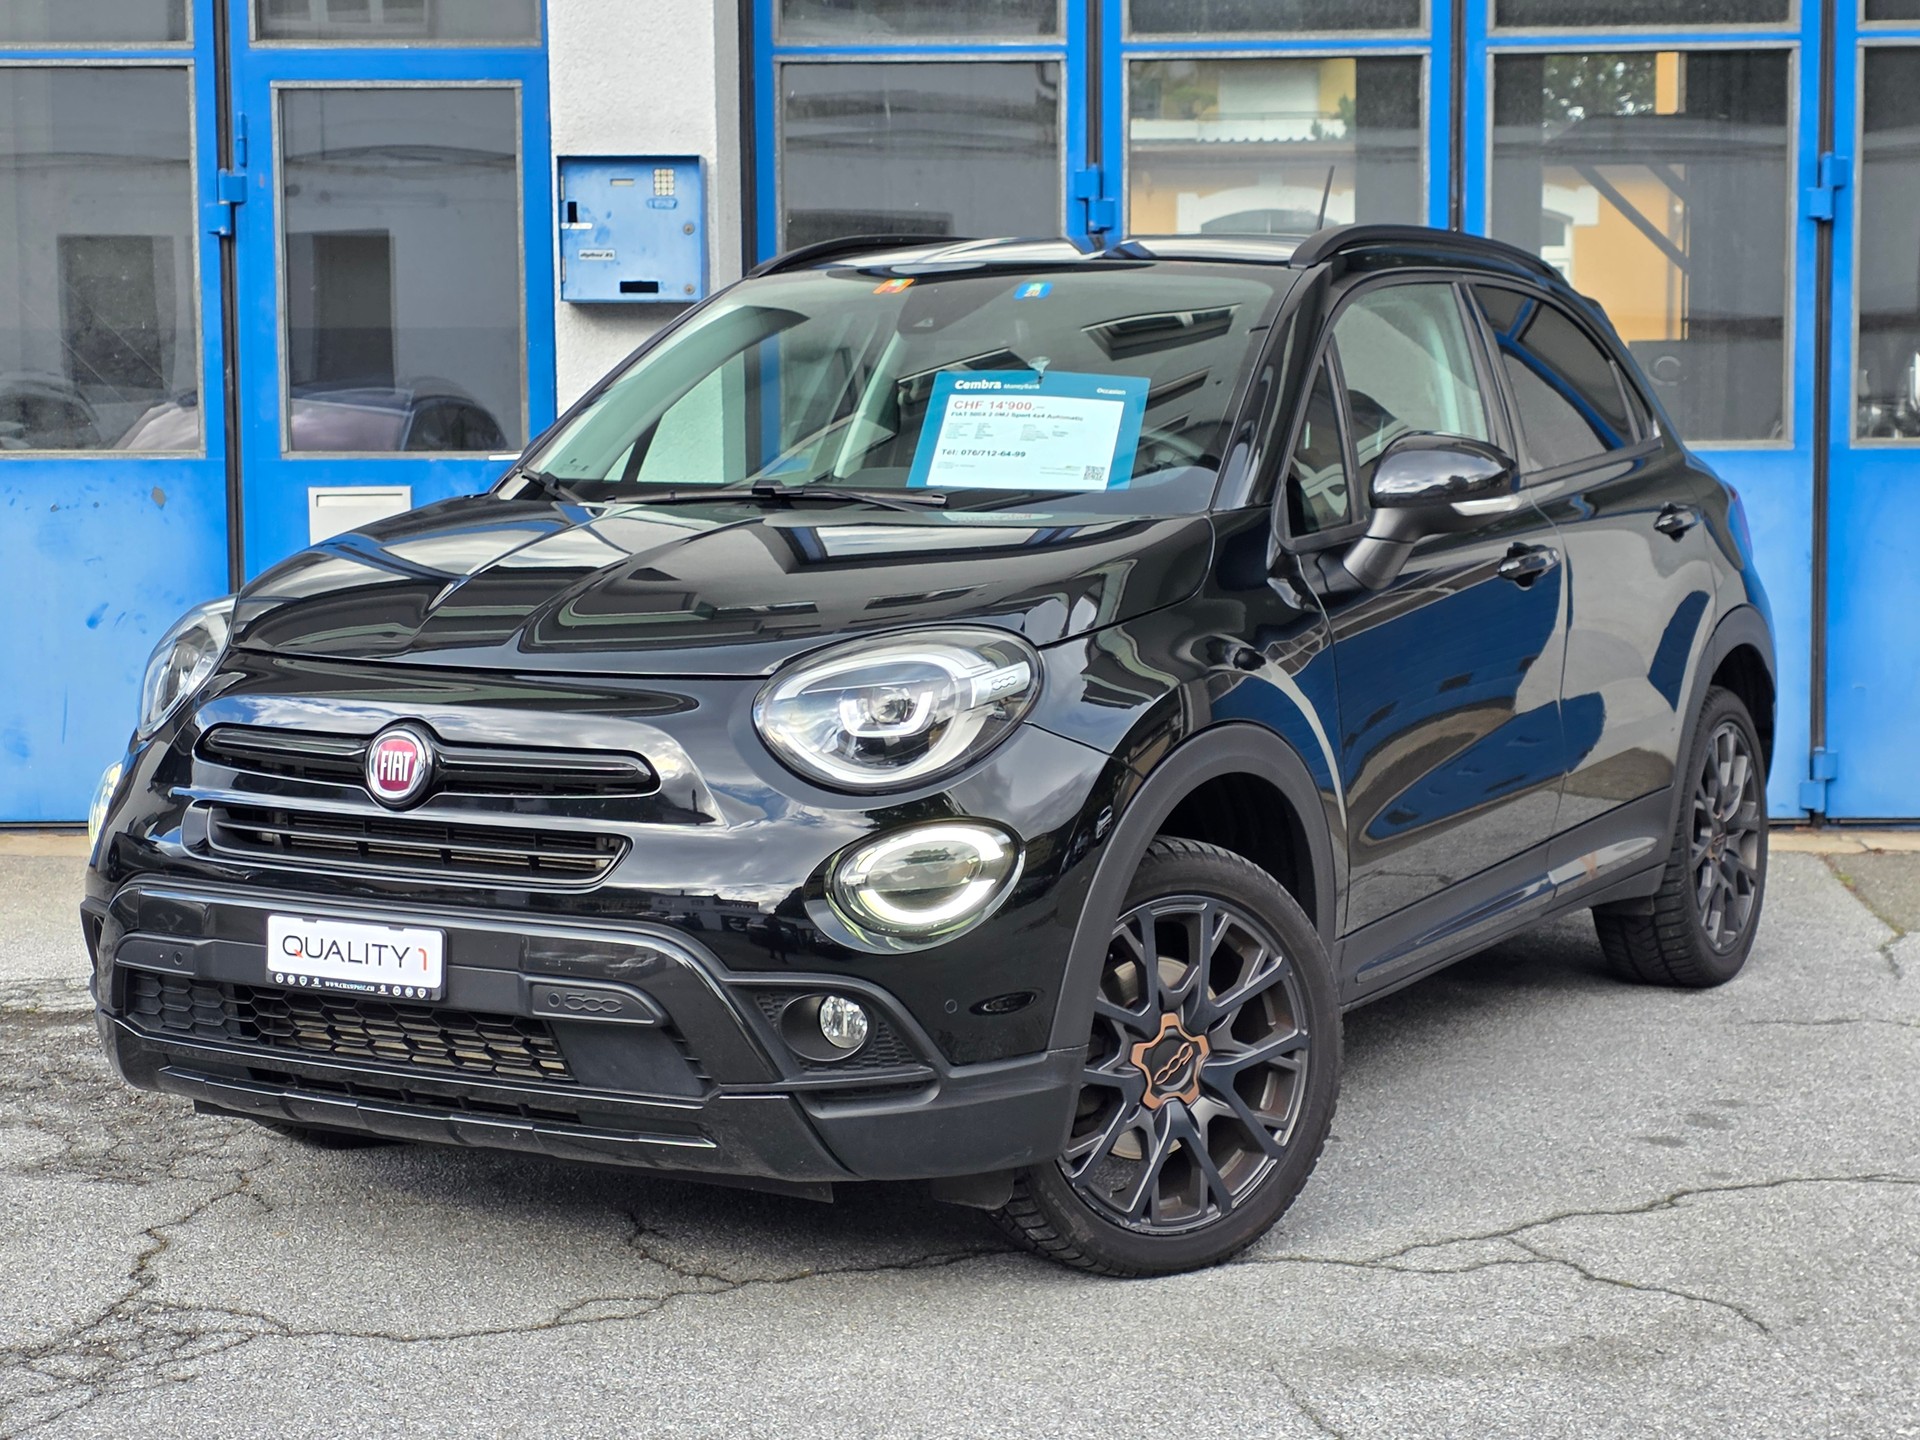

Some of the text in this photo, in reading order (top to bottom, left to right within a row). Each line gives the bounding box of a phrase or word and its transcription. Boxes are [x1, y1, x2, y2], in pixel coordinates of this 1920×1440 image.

[954, 379, 1002, 390] Cembra
[953, 400, 984, 410] CHF
[960, 448, 1027, 458] 076/712-64-99
[379, 750, 414, 782] FIAT
[564, 992, 623, 1014] 500
